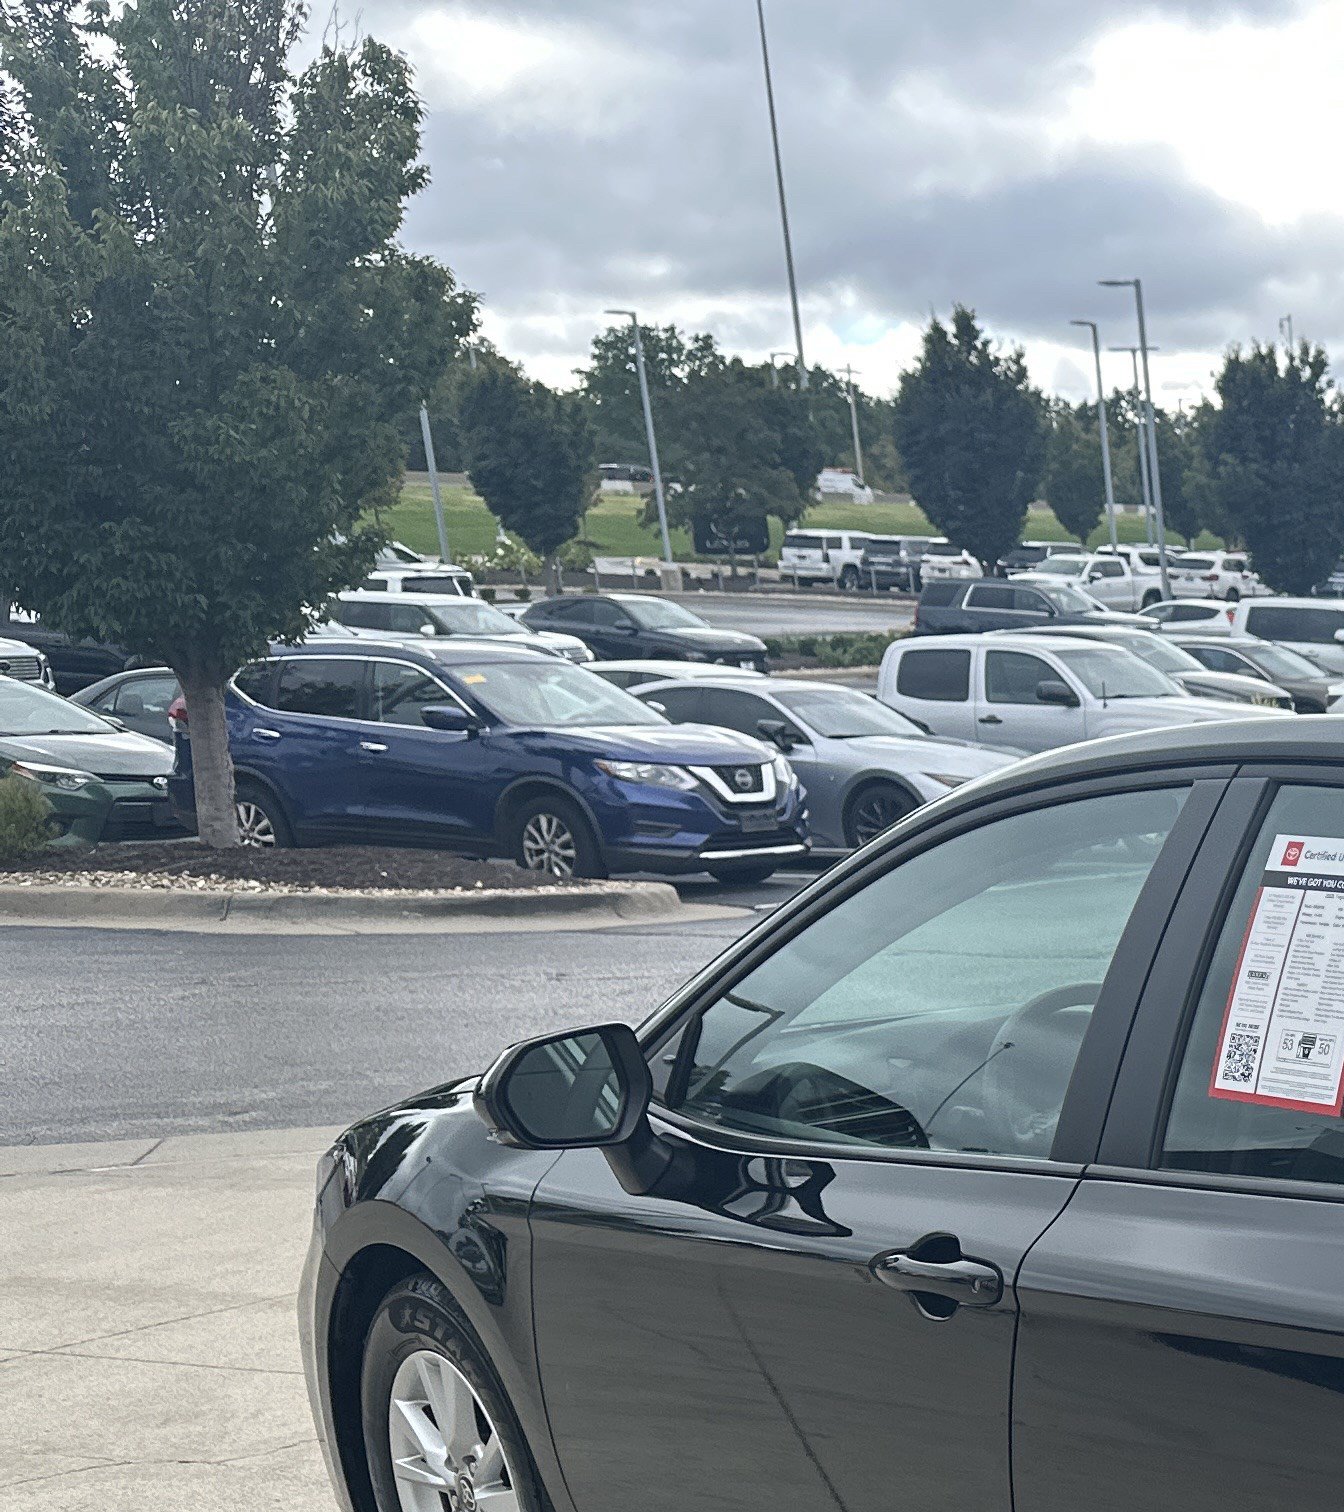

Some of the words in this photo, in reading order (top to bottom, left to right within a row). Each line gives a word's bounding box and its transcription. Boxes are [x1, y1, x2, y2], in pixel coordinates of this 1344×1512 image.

[1304, 850, 1336, 861] Certified
[1287, 876, 1307, 886] WE'VE
[1308, 878, 1323, 887] GOT
[1322, 879, 1337, 889] YOU
[1282, 1038, 1294, 1051] 53
[1318, 1042, 1331, 1056] 50
